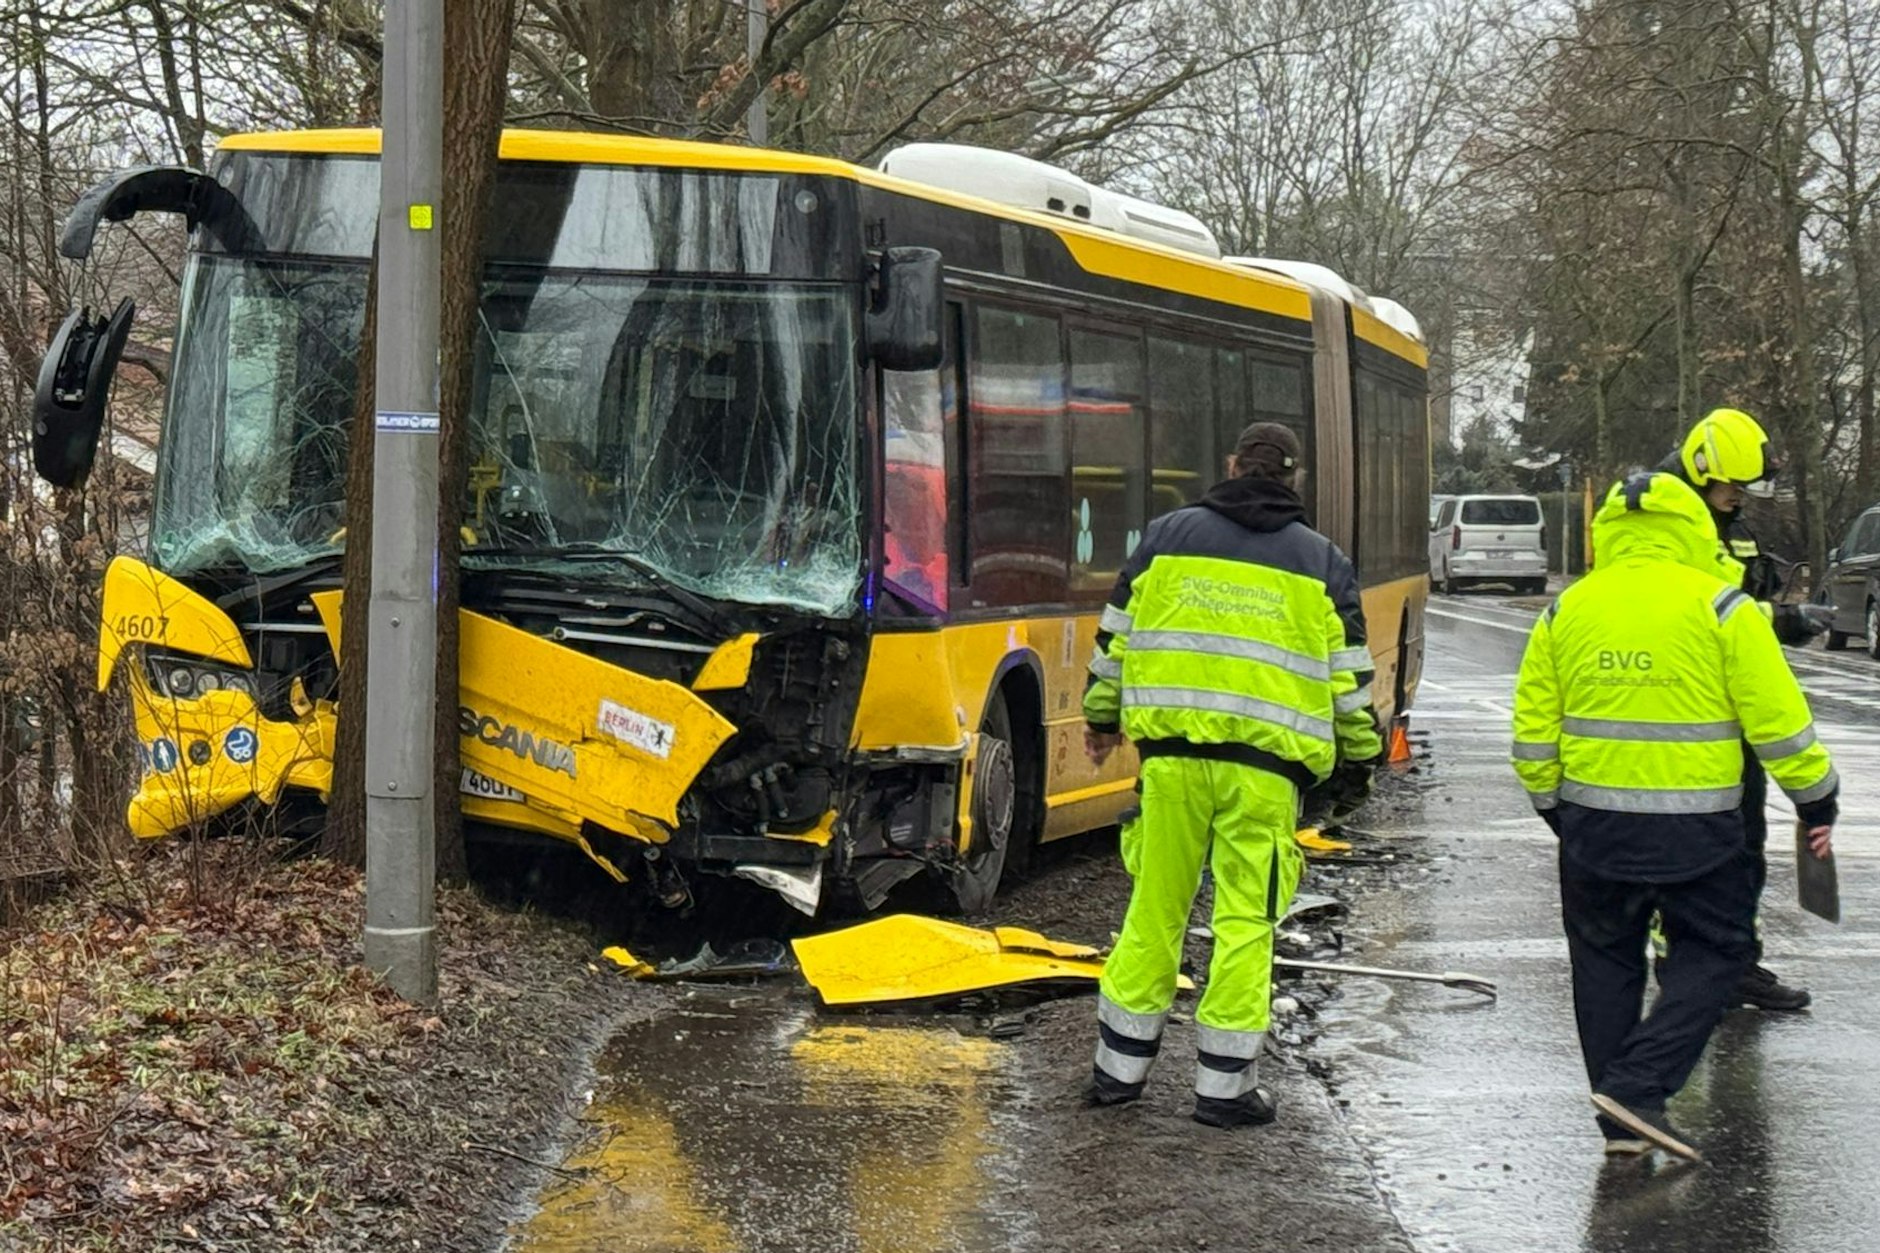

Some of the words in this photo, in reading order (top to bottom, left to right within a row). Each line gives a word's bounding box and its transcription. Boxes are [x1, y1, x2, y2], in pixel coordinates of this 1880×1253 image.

[116, 614, 171, 639] 4607
[1599, 650, 1652, 671] BVG
[604, 710, 645, 736] BERLIN
[459, 706, 577, 780] SCANIA
